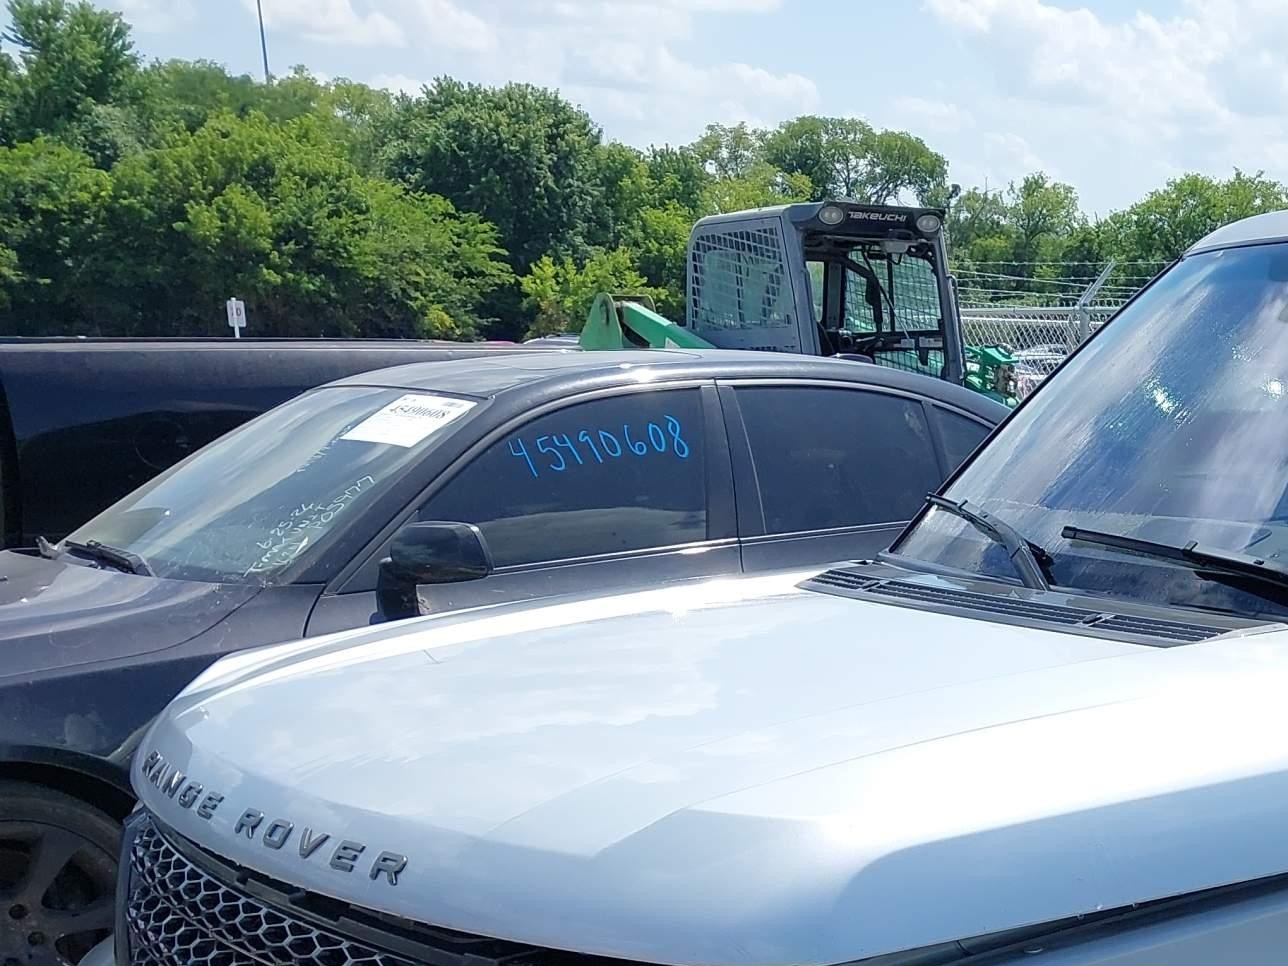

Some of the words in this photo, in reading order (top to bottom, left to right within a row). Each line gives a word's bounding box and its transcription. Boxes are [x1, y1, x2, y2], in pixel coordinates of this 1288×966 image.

[848, 211, 907, 222] TAKEUCHI
[508, 415, 689, 477] 45490608
[142, 750, 224, 820] RANGE
[234, 807, 408, 886] ROVER
